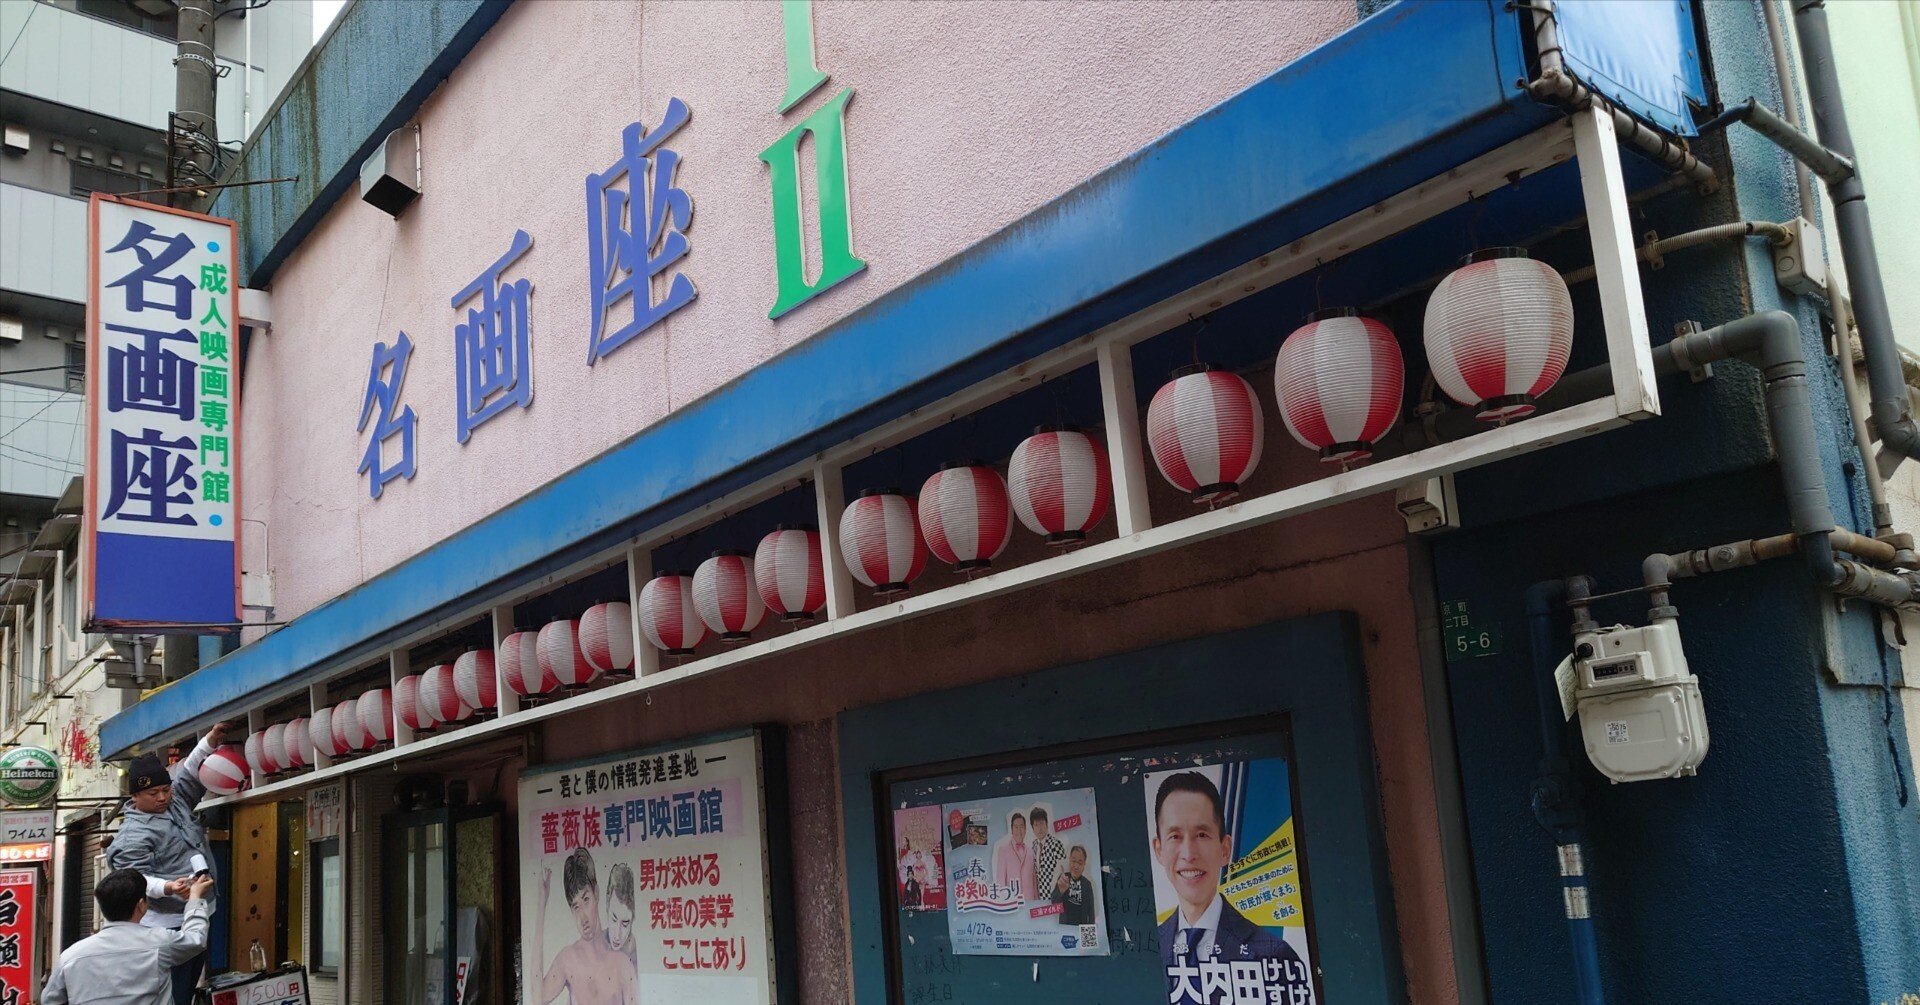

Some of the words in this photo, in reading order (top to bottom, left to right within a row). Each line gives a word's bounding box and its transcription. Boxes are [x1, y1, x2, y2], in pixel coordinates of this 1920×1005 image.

[356, 96, 698, 500] 名画座
[101, 219, 199, 527] 名画座
[199, 263, 230, 504] 成人映画専門館
[1445, 615, 1468, 628] 二丁目
[1457, 632, 1491, 652] 5-6
[1, 768, 55, 779] Heineken
[559, 749, 699, 798] 君と僕の情報発進基地
[8, 827, 47, 840] ワイムズ
[541, 787, 724, 854] 薔薇族専門映画館
[640, 853, 721, 891] 男が求める
[955, 878, 1021, 901] お笑いまつり
[650, 893, 735, 930] 究極の美学
[663, 935, 746, 971] ここにあり
[1167, 955, 1266, 1005] 大内田
